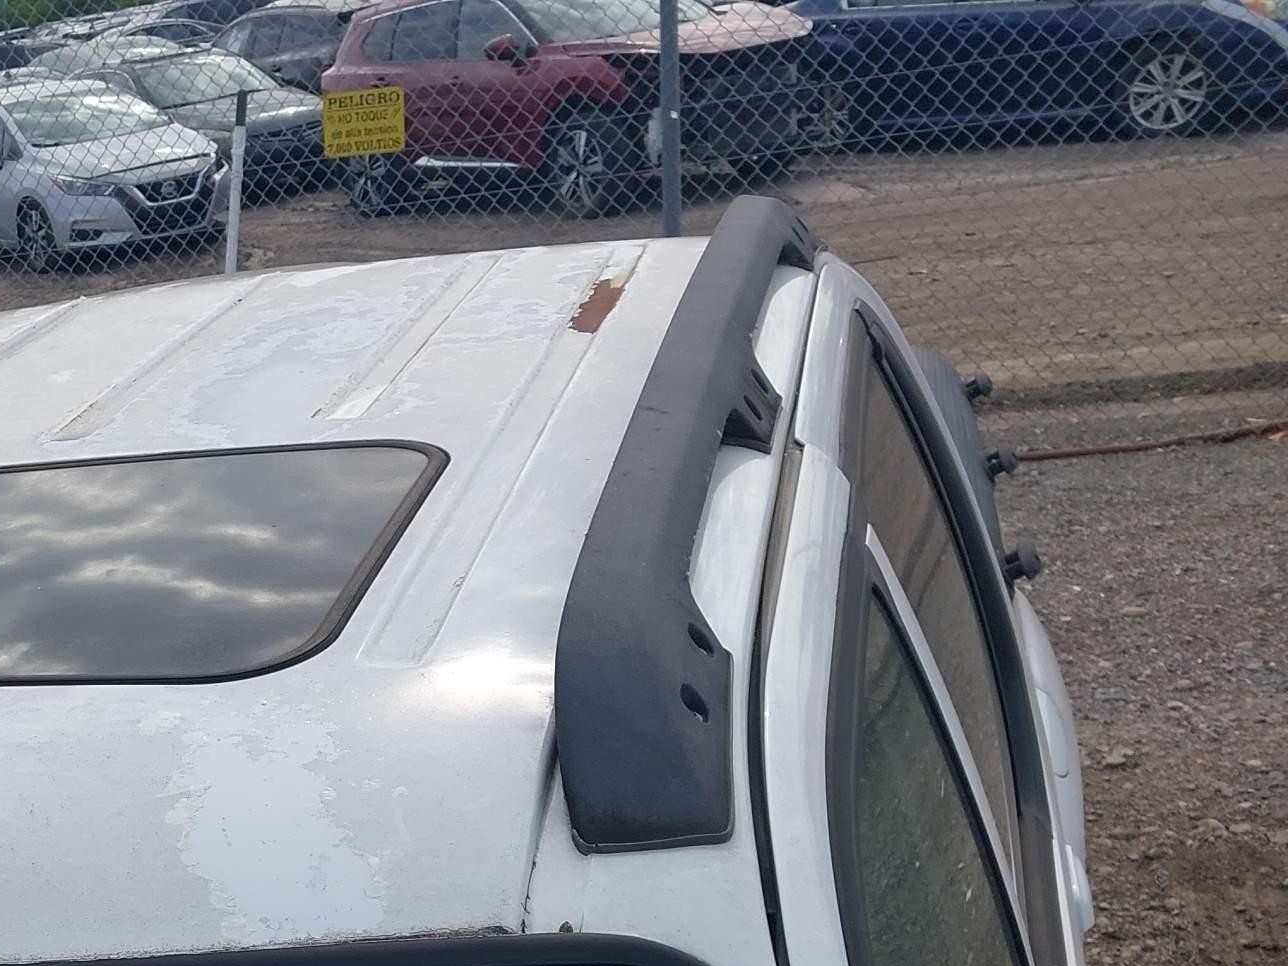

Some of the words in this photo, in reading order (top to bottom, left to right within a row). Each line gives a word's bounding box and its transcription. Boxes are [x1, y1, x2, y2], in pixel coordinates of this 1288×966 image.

[327, 90, 400, 109] PELIGRO
[338, 111, 352, 124] NO
[355, 109, 389, 122] TOQUE
[355, 137, 402, 152] VOLTIOS
